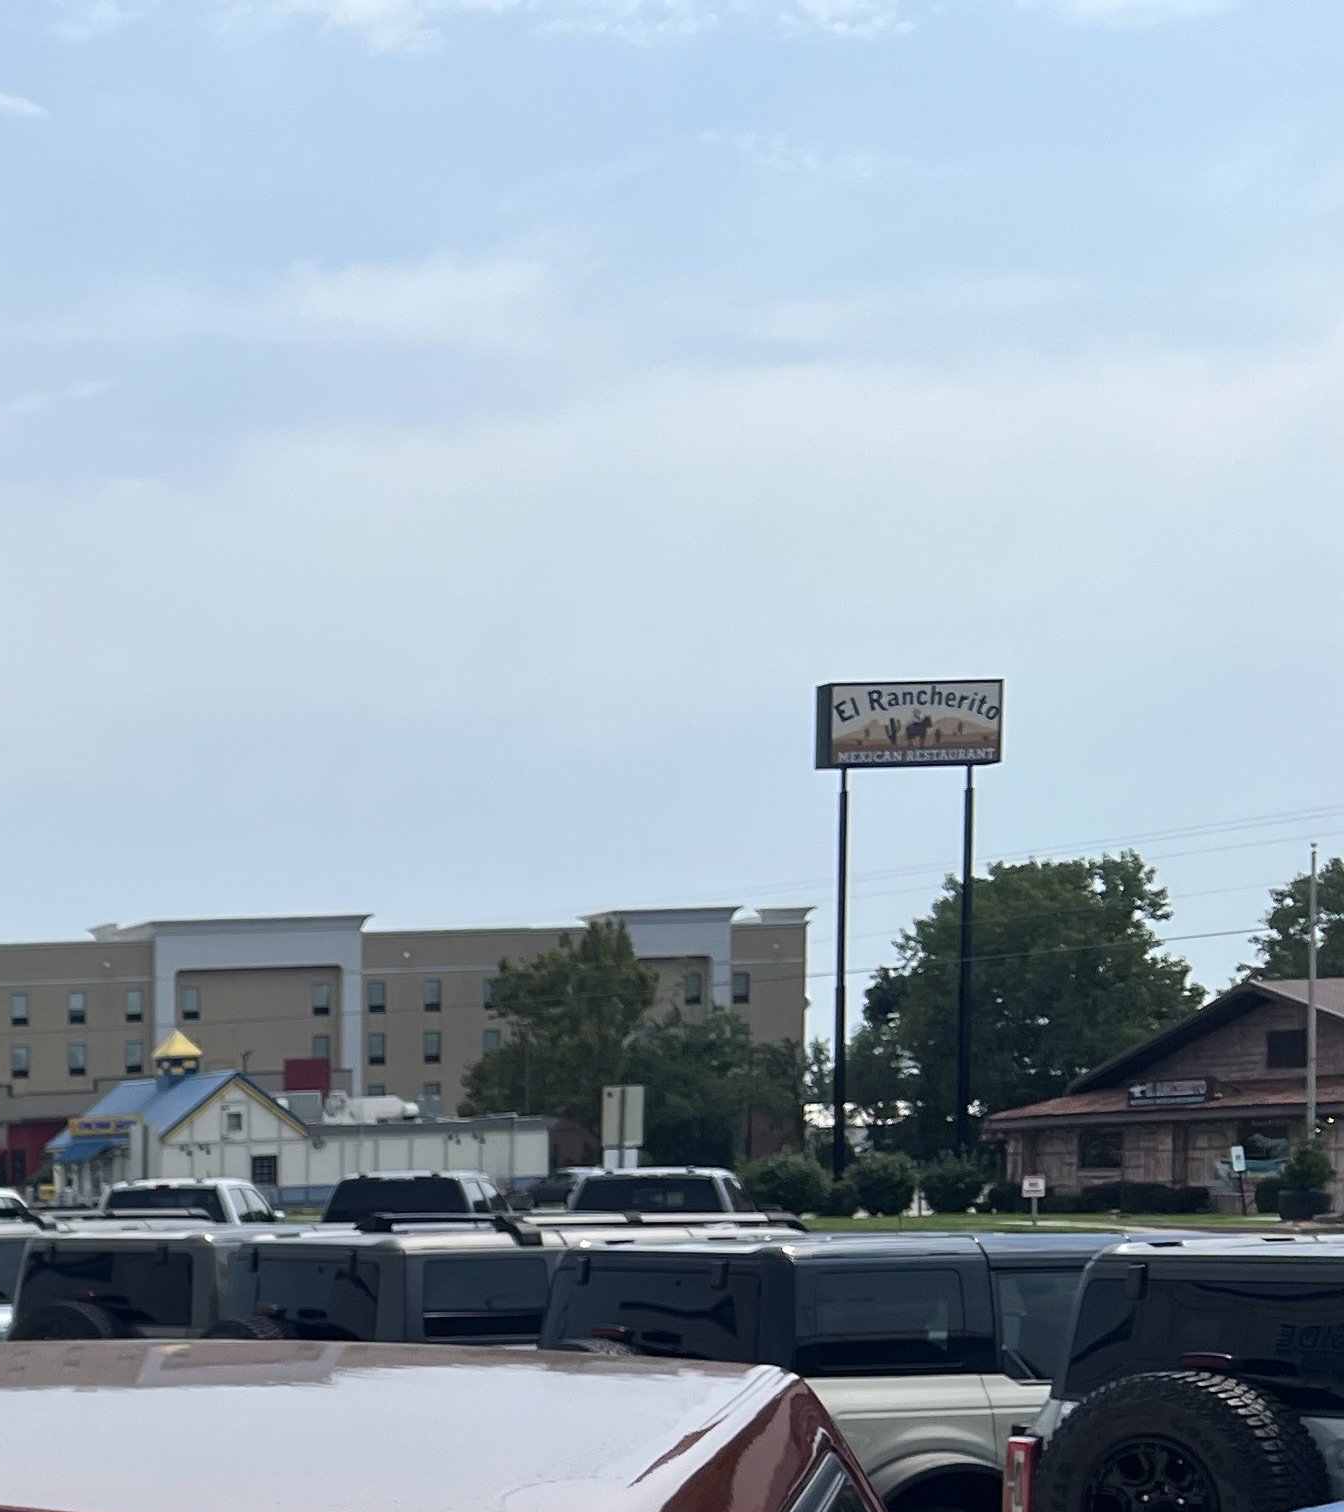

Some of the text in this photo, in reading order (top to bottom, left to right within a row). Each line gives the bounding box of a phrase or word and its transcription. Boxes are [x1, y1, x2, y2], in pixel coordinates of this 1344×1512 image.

[834, 685, 1000, 722] El Rancherito
[838, 748, 997, 763] MEXICAN RESTAURANT
